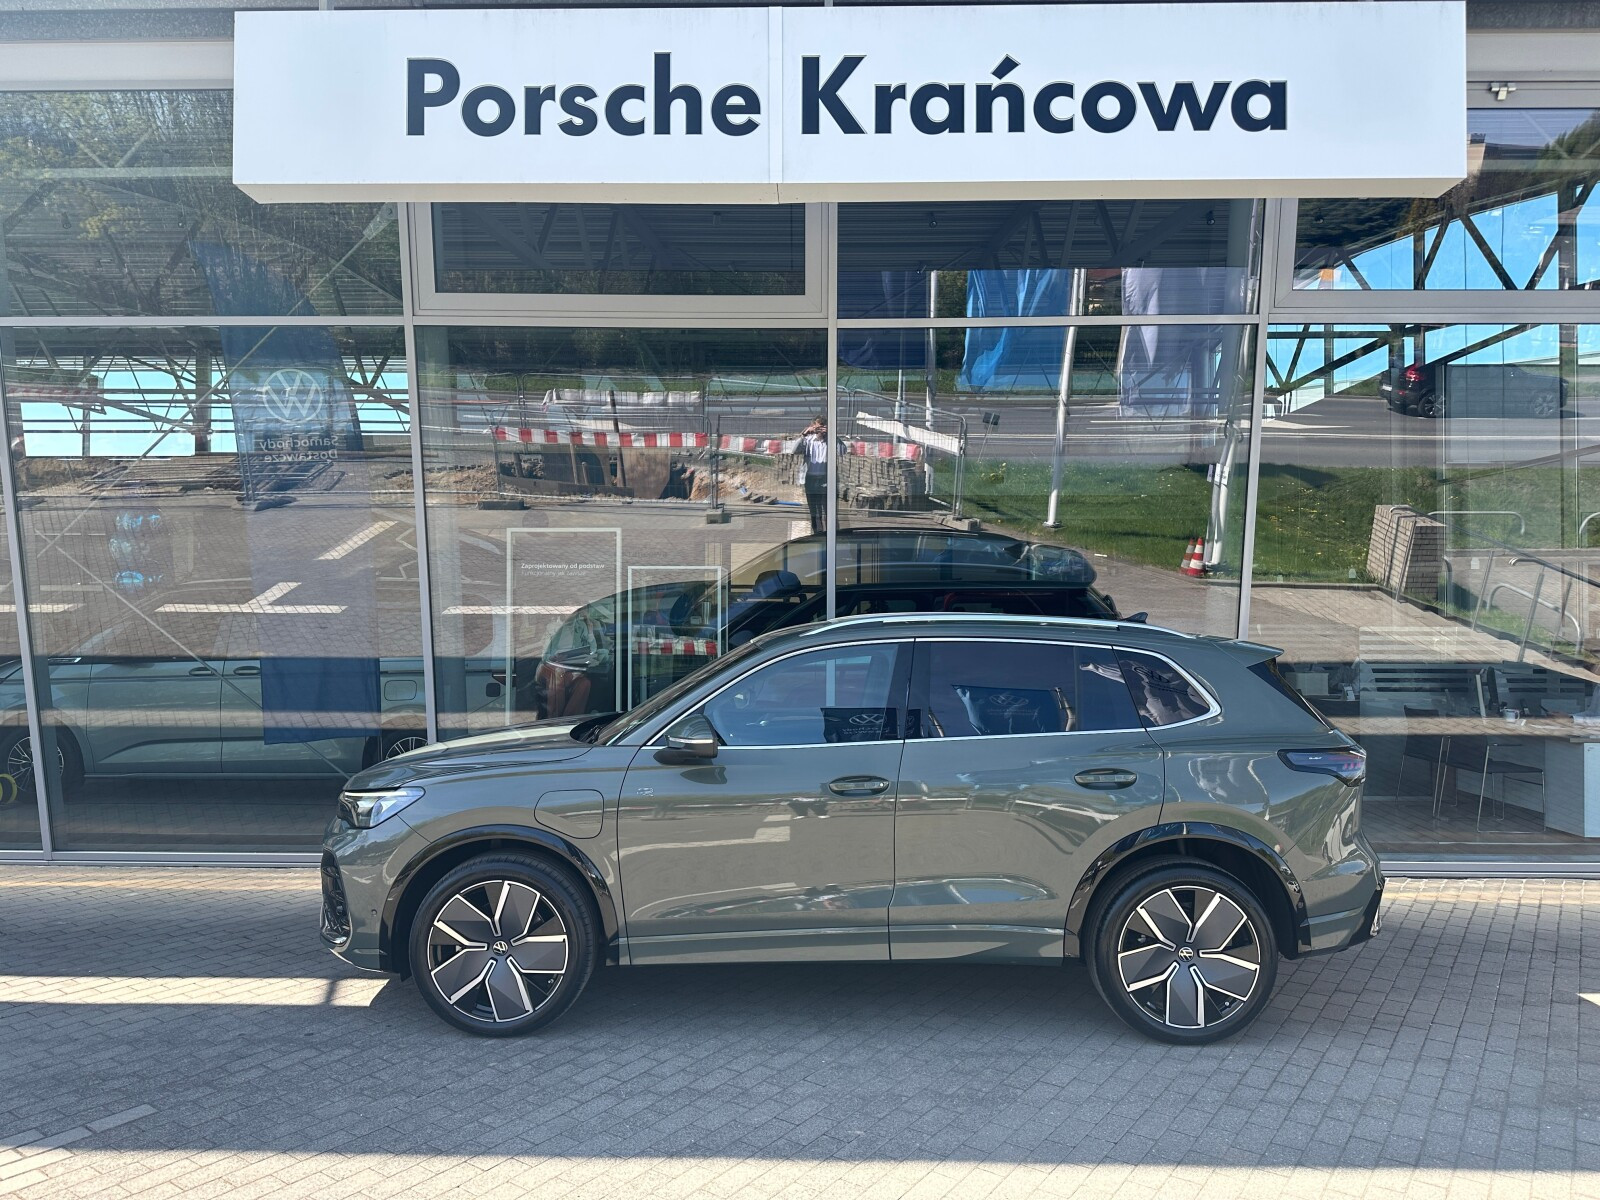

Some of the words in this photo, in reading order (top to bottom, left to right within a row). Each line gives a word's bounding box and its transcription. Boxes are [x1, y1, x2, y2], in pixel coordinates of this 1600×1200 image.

[406, 51, 761, 137] Porsche
[801, 54, 1288, 135] Krańcowa
[521, 562, 568, 570] Zaprojektowany
[578, 562, 605, 570] podstaw
